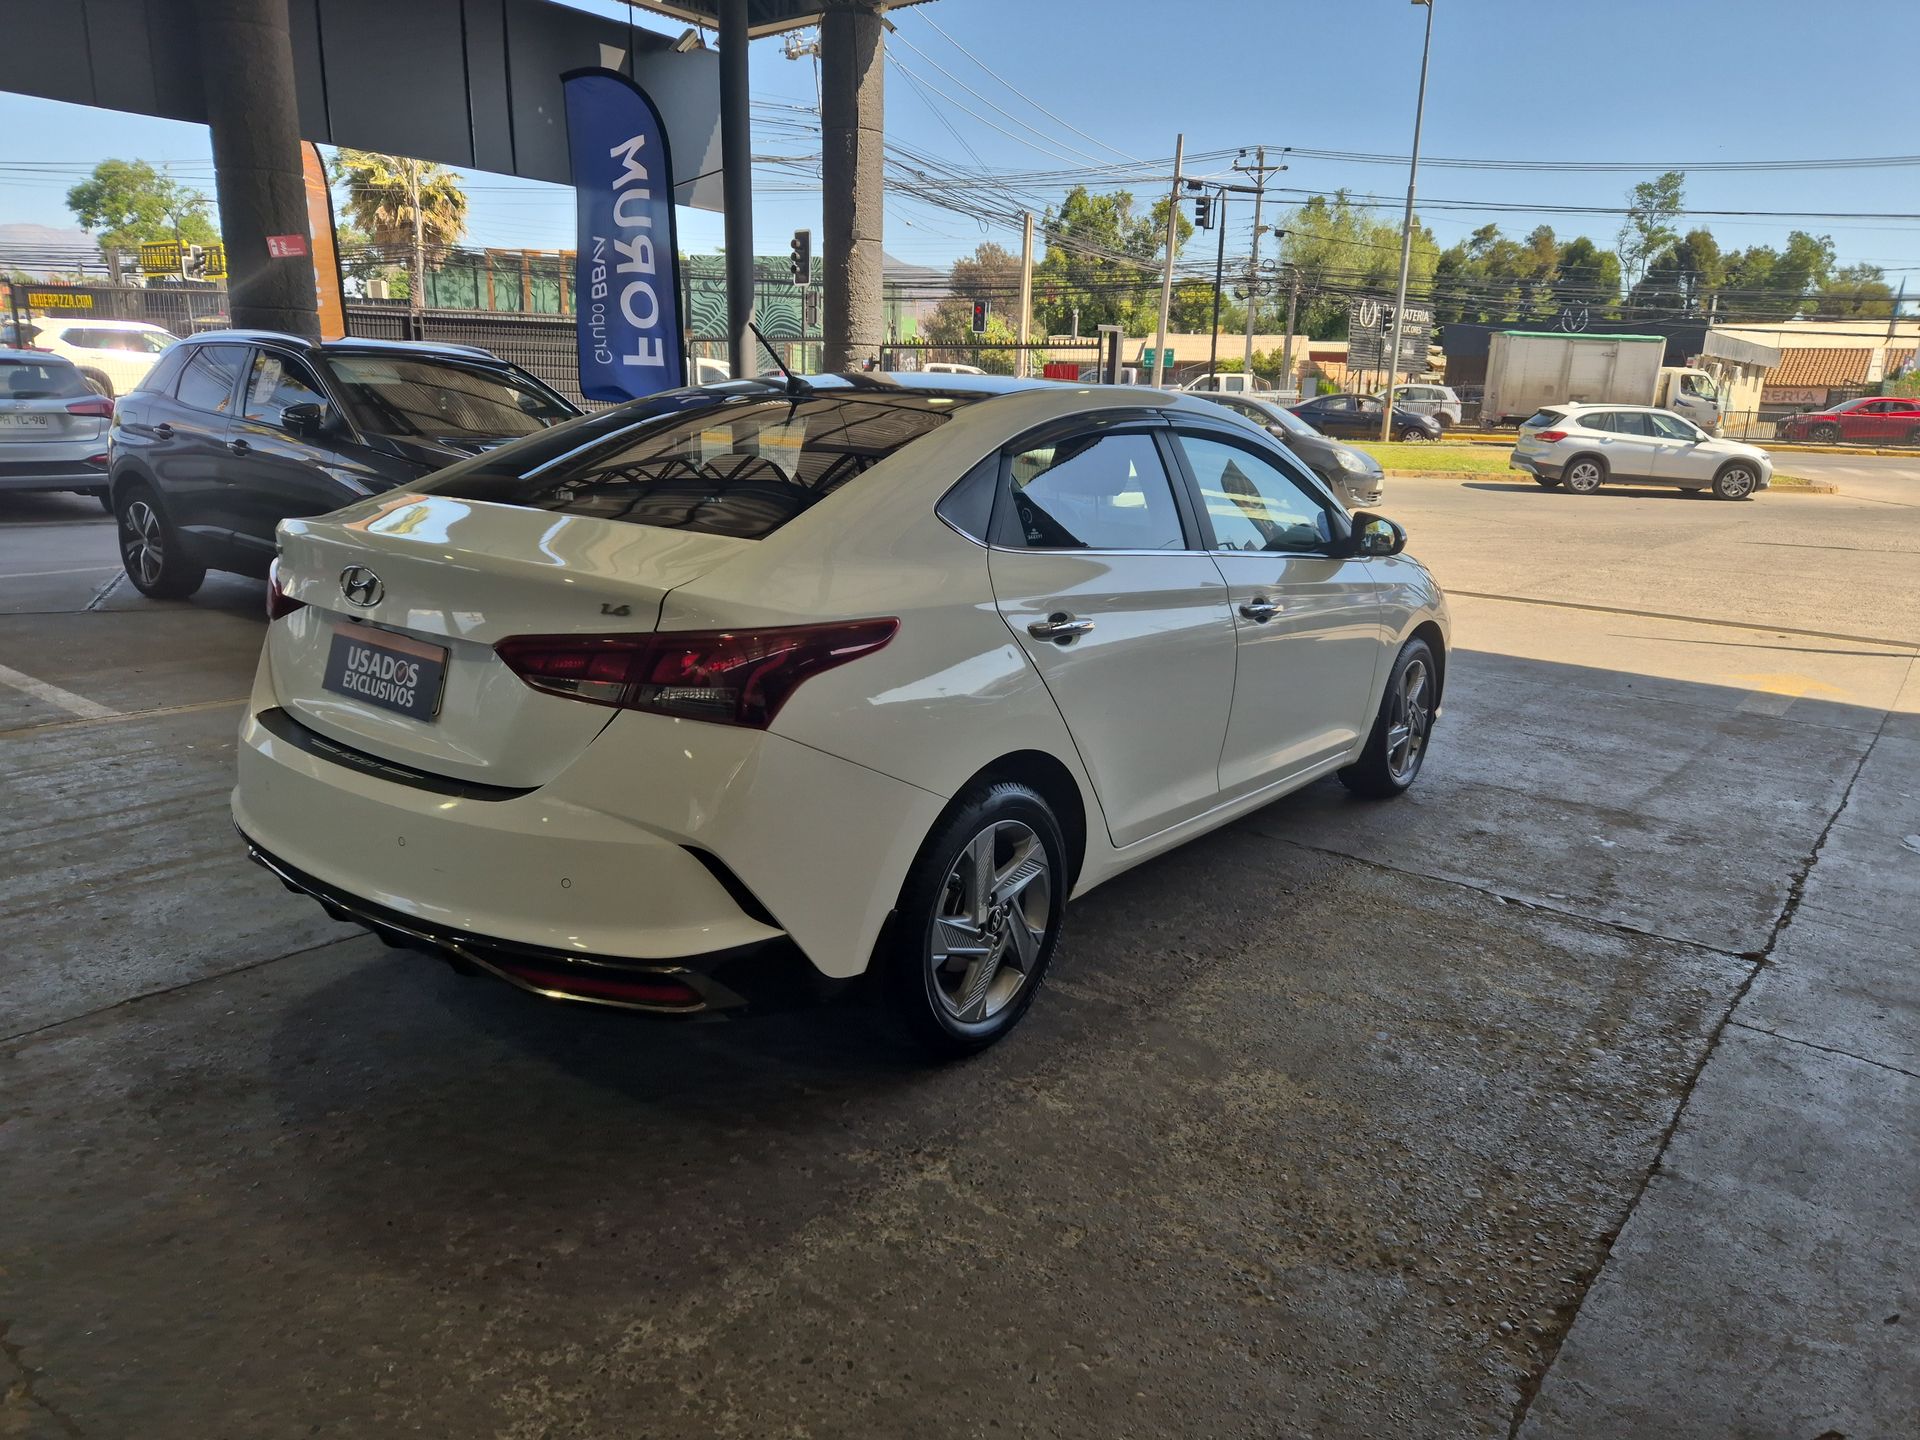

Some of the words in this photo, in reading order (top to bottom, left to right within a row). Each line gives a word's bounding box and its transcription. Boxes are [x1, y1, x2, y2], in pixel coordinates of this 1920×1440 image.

[28, 293, 93, 308] UNDERPIZZA.COM
[601, 603, 631, 617] 1.6
[347, 646, 420, 688] USADOS
[342, 670, 415, 708] EXCLUSIVOS
